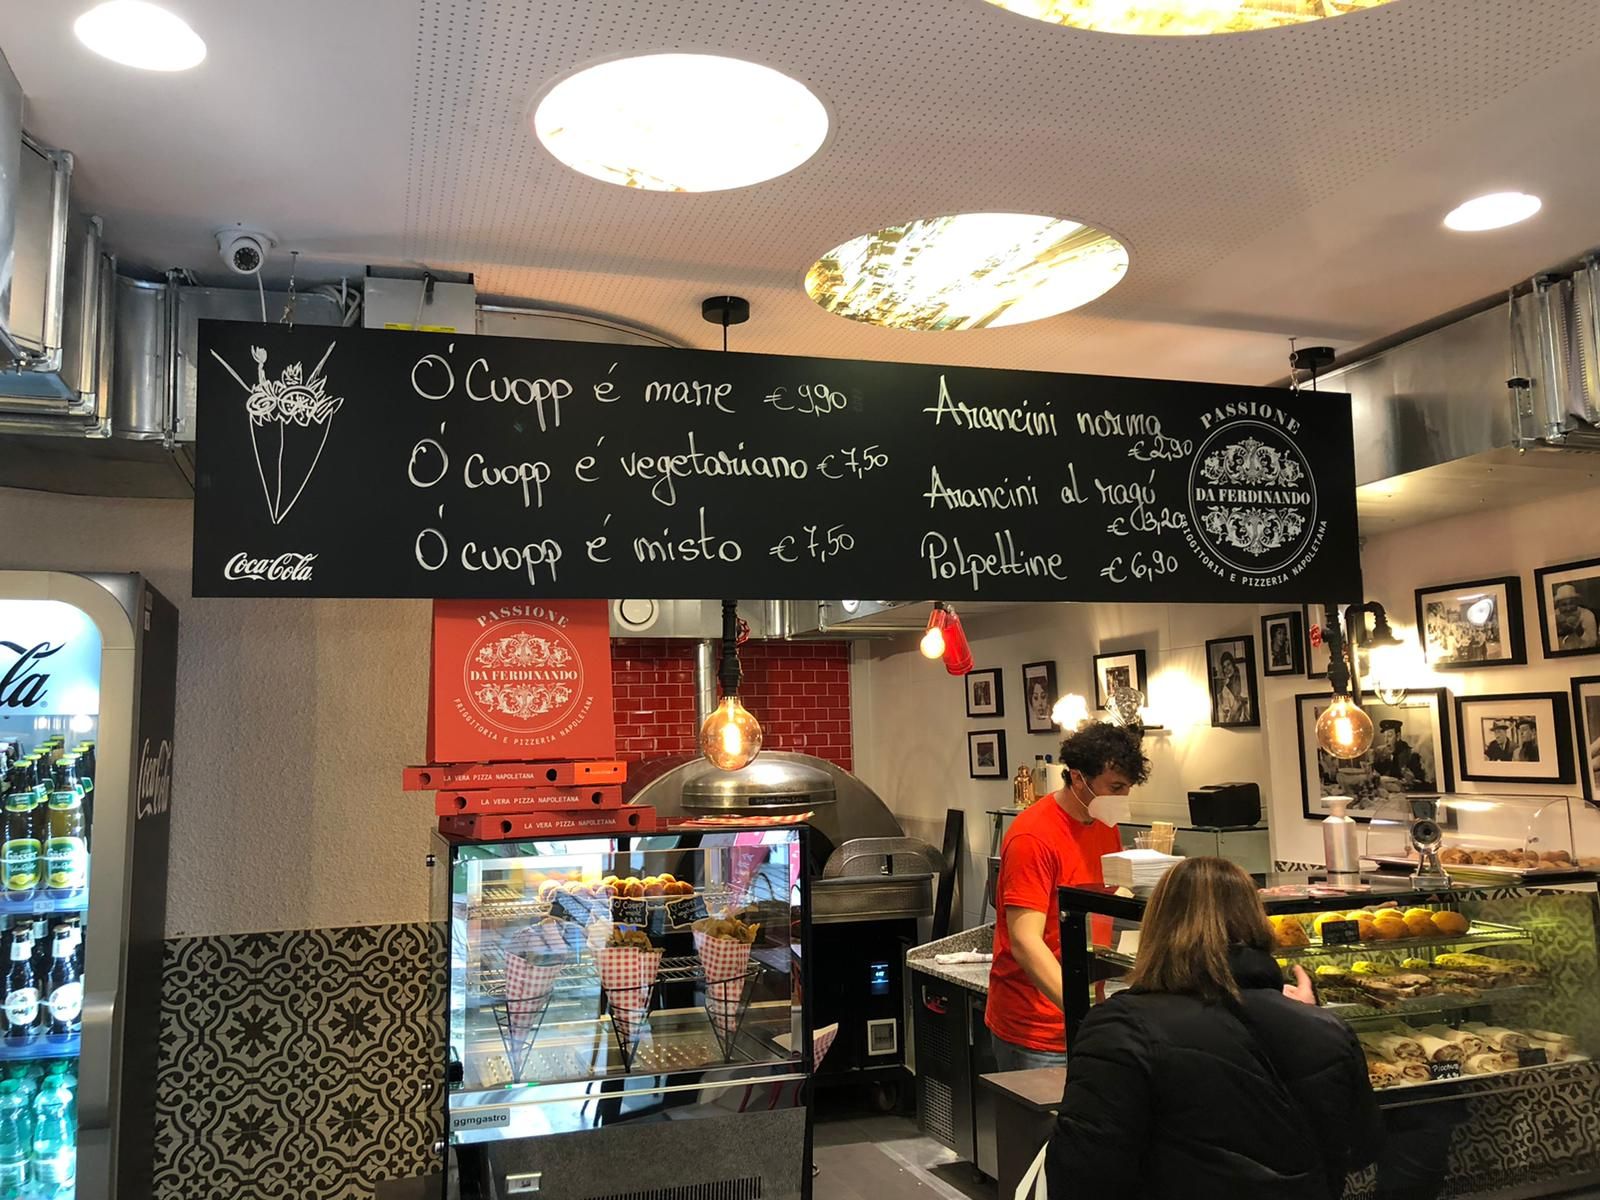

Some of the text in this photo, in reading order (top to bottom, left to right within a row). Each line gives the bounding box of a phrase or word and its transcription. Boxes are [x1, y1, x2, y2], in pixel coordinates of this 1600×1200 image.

[466, 358, 573, 432] Cuopp
[923, 375, 1166, 439] Arancini norma
[1200, 401, 1301, 435] PASSIONE
[621, 432, 807, 506] vegetariano
[923, 466, 1038, 509] Arancini
[1061, 463, 1088, 505] al
[1195, 487, 1311, 505] DA FERDINANDO
[634, 506, 742, 563] misto
[224, 552, 318, 582] Coca-Cola
[921, 530, 1067, 592] Polpettine
[1229, 573, 1237, 582] E
[1242, 573, 1290, 588] PIZZERIA
[1292, 519, 1328, 576] NAPOLETANA
[476, 605, 569, 628] PASSIONE
[470, 670, 578, 681] DA FERDINANDO
[453, 695, 595, 746] FRIGGITORIA E PIZZERIA NAPOLETANA
[455, 774, 470, 782] VERA
[473, 773, 493, 781] PIZZA
[495, 772, 535, 780] NAPOLETANA
[538, 795, 580, 804] NAPOLETANA
[535, 821, 553, 829] VERA
[555, 820, 576, 828] PIZZA
[578, 818, 616, 827] NAPOLETANA
[453, 1114, 508, 1128] ggmgastro
